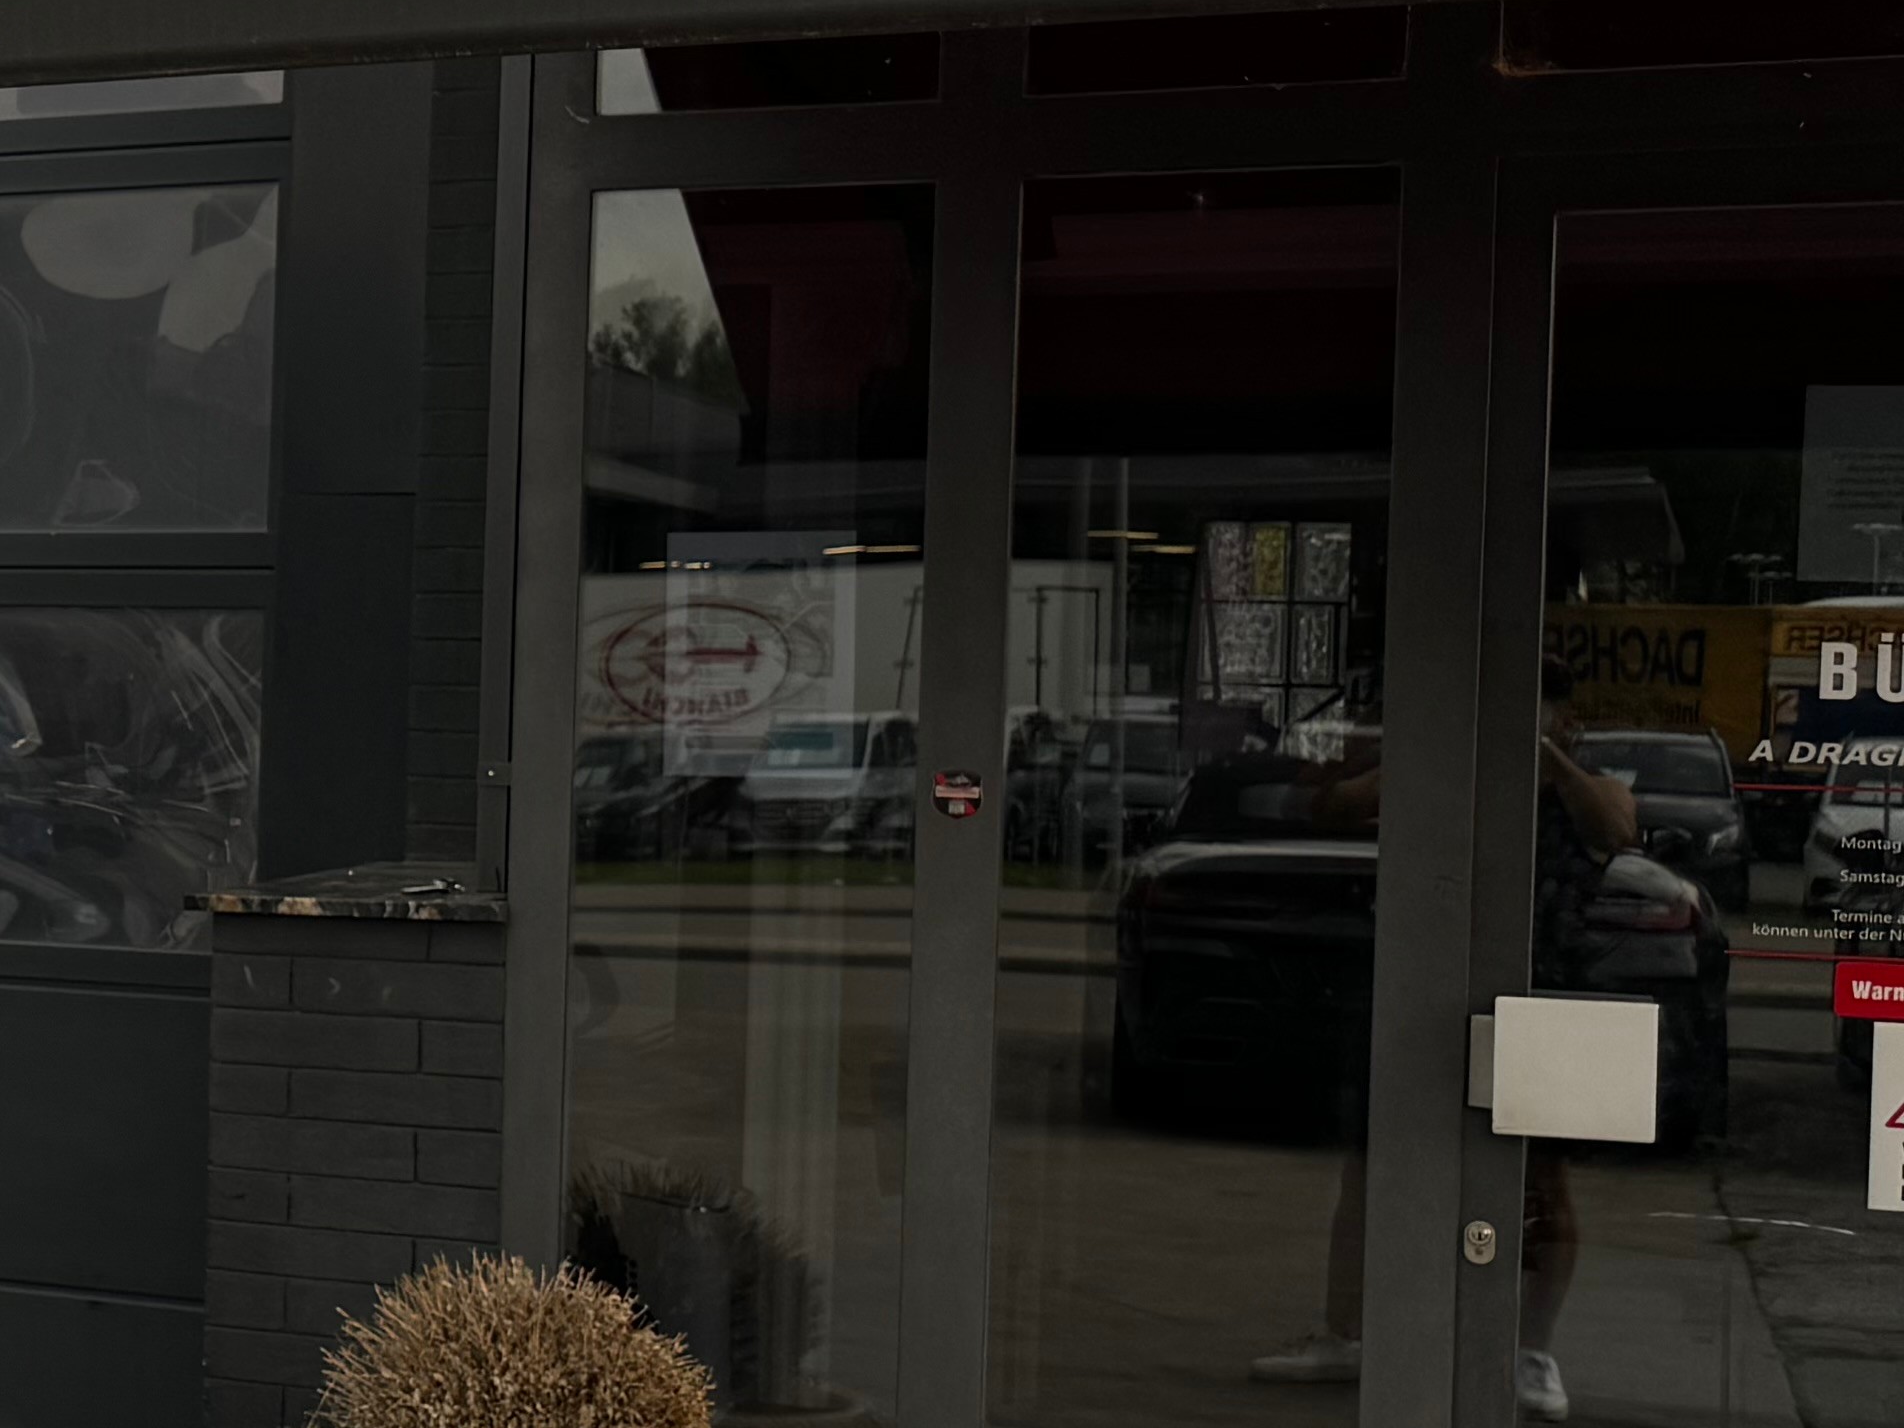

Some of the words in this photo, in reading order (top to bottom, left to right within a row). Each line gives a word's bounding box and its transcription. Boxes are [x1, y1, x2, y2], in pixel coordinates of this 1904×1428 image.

[1788, 741, 1904, 767] DRAG
[1841, 835, 1902, 854] Montag
[1839, 868, 1904, 888] Samstag
[1831, 908, 1894, 924] Termine
[1752, 922, 1809, 938] können
[1810, 926, 1856, 941] unter
[1858, 926, 1886, 942] der
